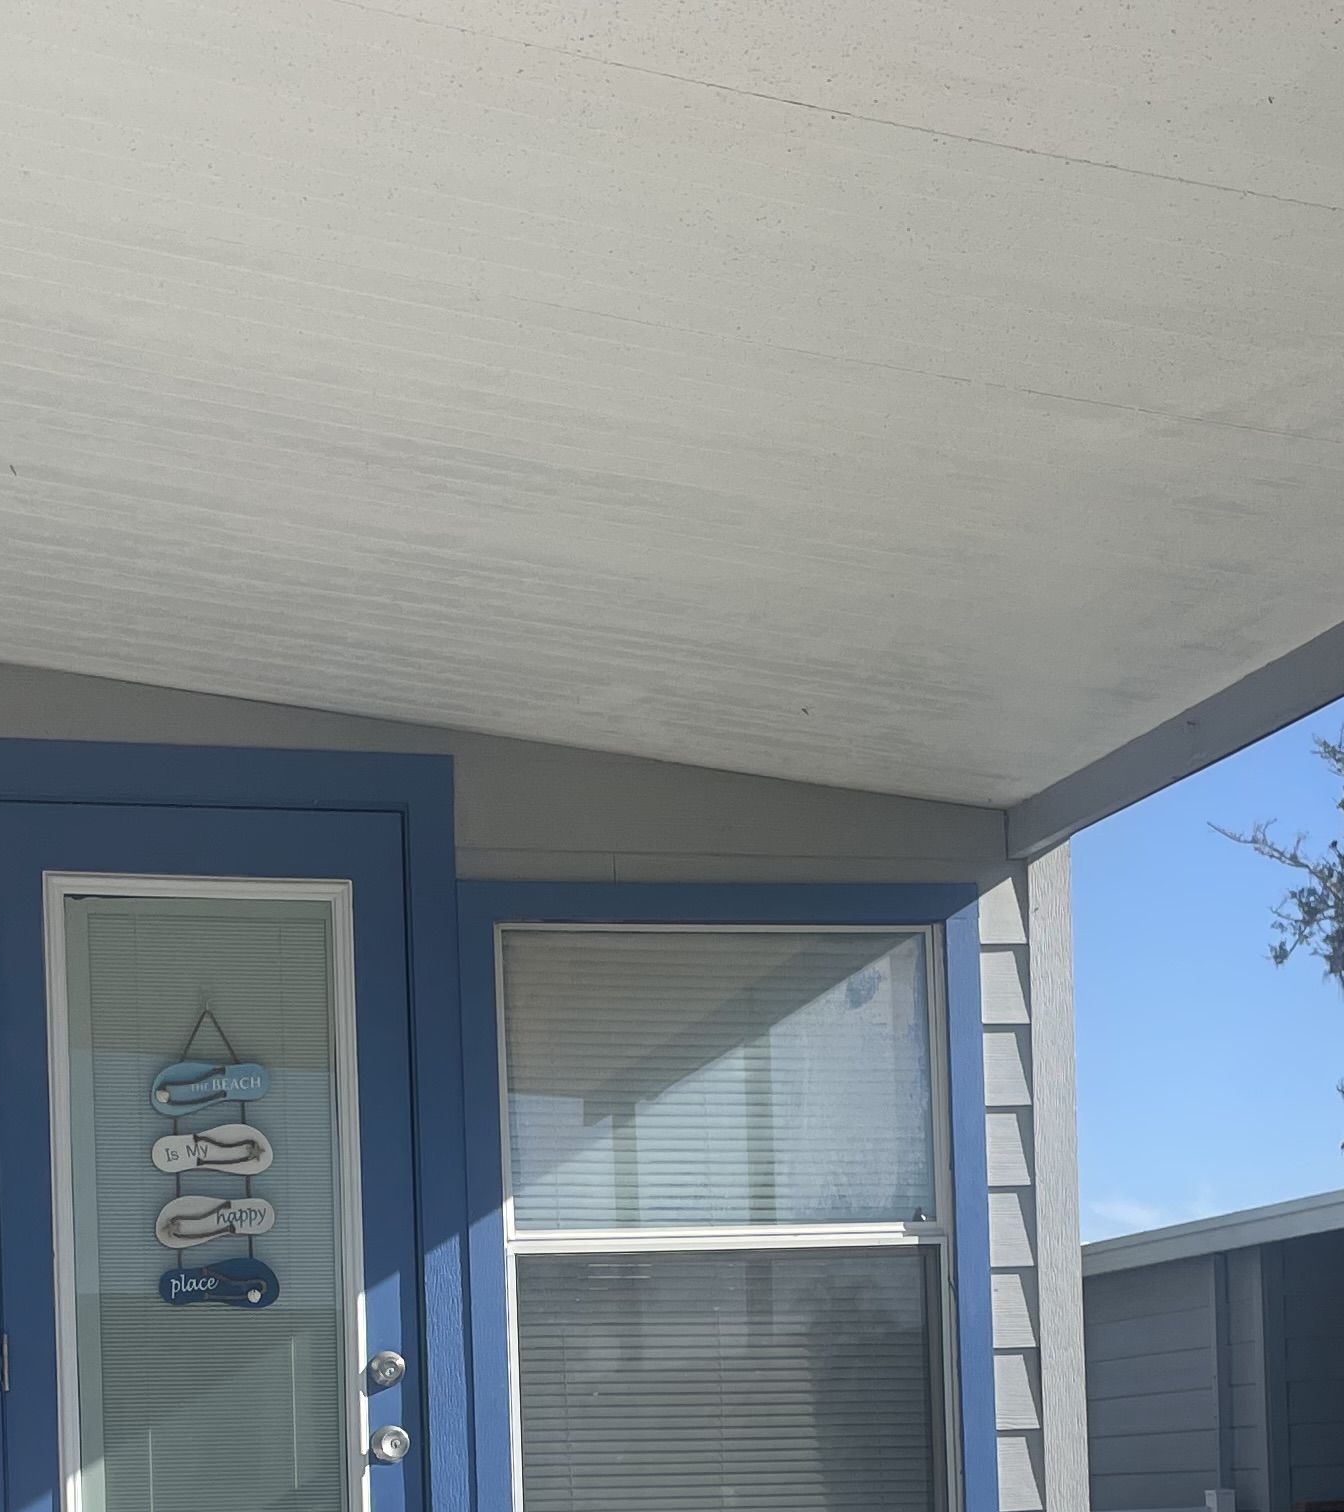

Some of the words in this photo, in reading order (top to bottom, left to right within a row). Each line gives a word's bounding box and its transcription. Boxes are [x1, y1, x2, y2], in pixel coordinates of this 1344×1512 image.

[191, 1082, 209, 1092] THE
[212, 1076, 261, 1091] BEACH
[165, 1148, 179, 1162] Is
[186, 1143, 208, 1158] My
[216, 1207, 266, 1228] happy
[170, 1273, 219, 1299] place
